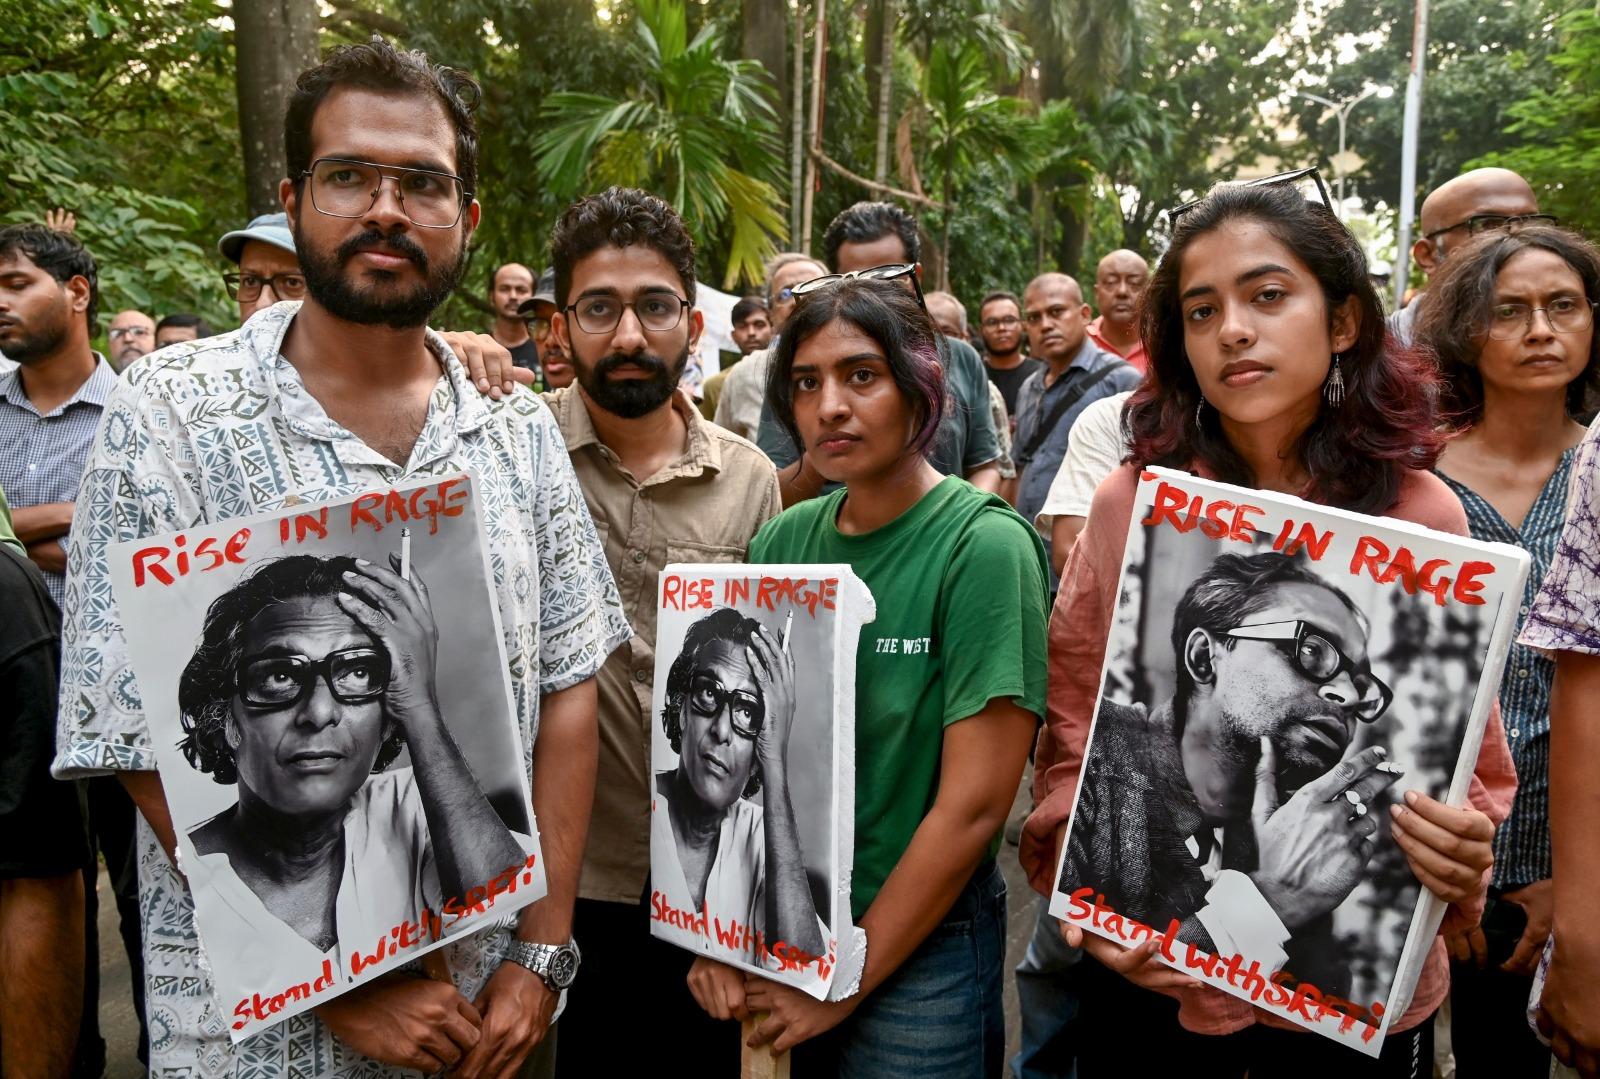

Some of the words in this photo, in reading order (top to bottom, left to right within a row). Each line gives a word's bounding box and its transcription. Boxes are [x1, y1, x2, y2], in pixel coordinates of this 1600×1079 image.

[132, 527, 251, 587] Rise
[279, 507, 328, 544] IN
[350, 474, 470, 535] RAGE
[1141, 481, 1265, 544] RISE
[1272, 519, 1334, 561] IN
[1349, 535, 1496, 606] RAGE
[662, 575, 715, 611] RISE
[724, 577, 749, 607] IN
[757, 576, 839, 618] RAGE
[875, 637, 899, 654] THE
[650, 890, 712, 938] Stand
[1067, 887, 1180, 963] Stand
[231, 959, 335, 1030] Stand
